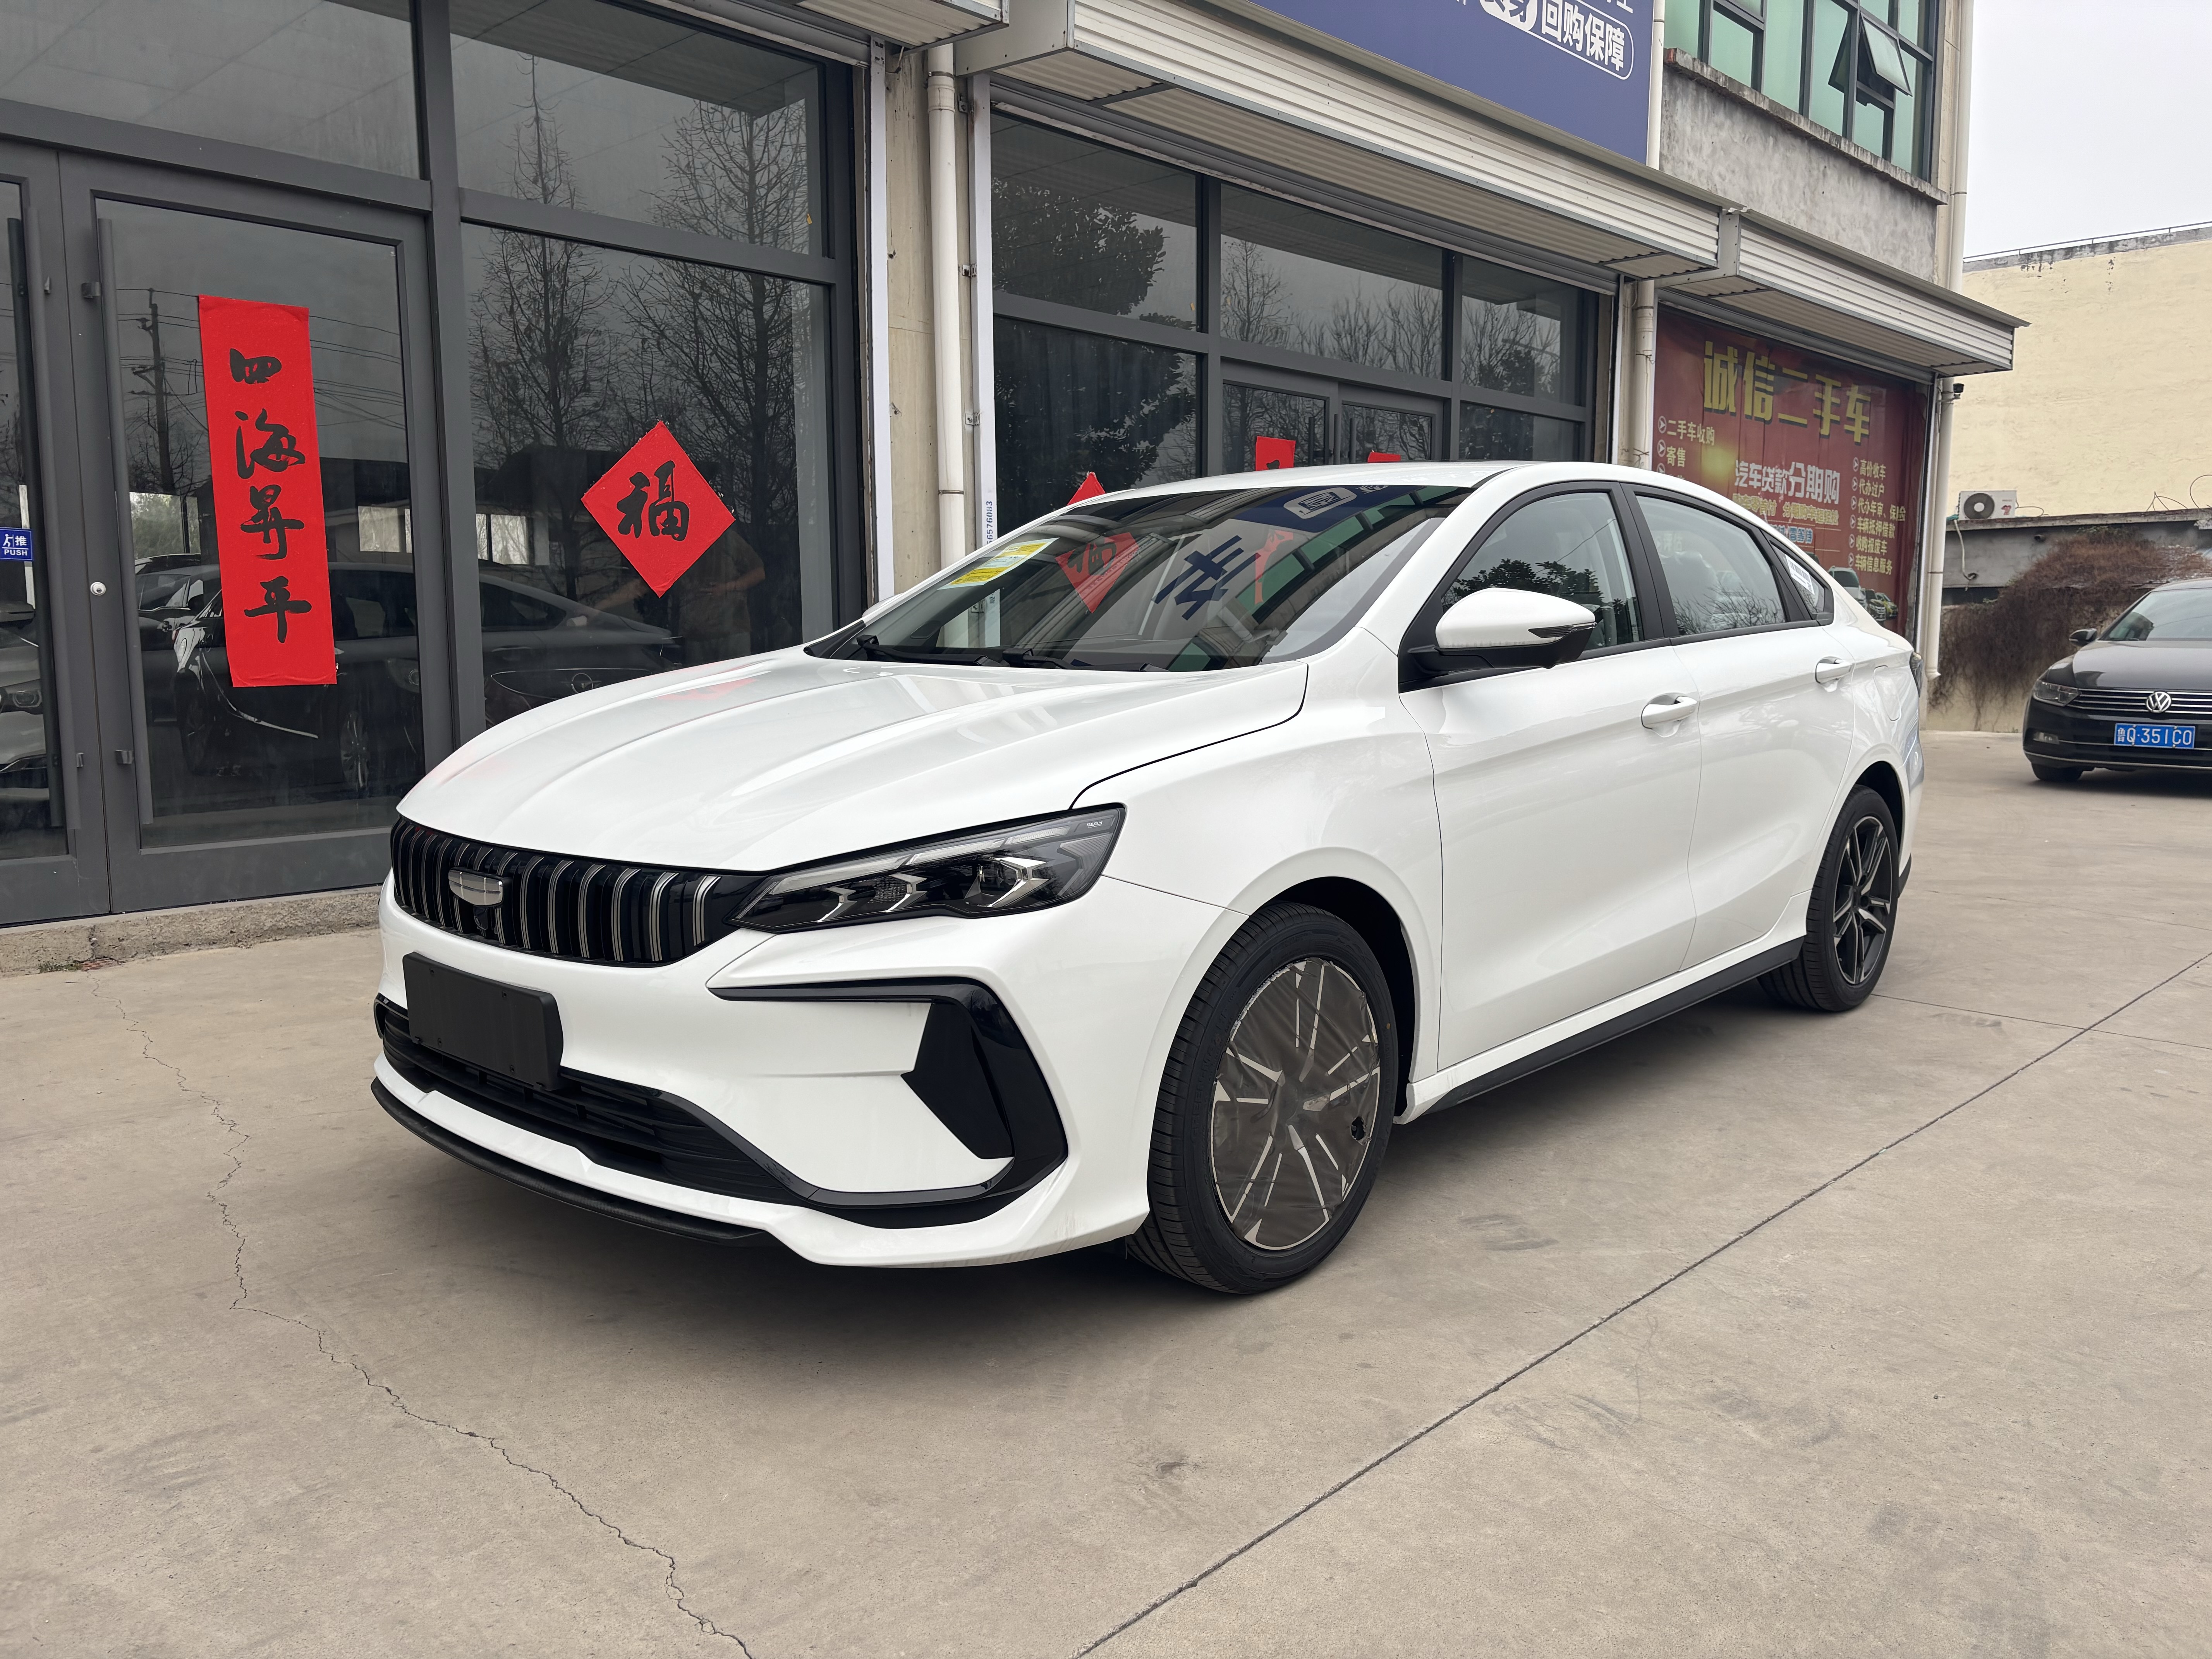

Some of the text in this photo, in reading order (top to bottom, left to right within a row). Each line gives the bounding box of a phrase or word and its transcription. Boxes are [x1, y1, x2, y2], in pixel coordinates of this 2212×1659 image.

[1542, 0, 1625, 71] 回购保障
[1704, 341, 1871, 445] 诚信二手车
[1667, 420, 1715, 446] 二手车收购
[1666, 446, 1686, 467] 寄售
[1735, 460, 1840, 504] 汽车贷款分期购
[1860, 459, 1886, 481] 高价收车
[1858, 478, 1885, 498] 代办过户
[617, 460, 690, 541] 福
[14, 536, 27, 546] 推
[1855, 553, 1893, 575] 车辆信息服务
